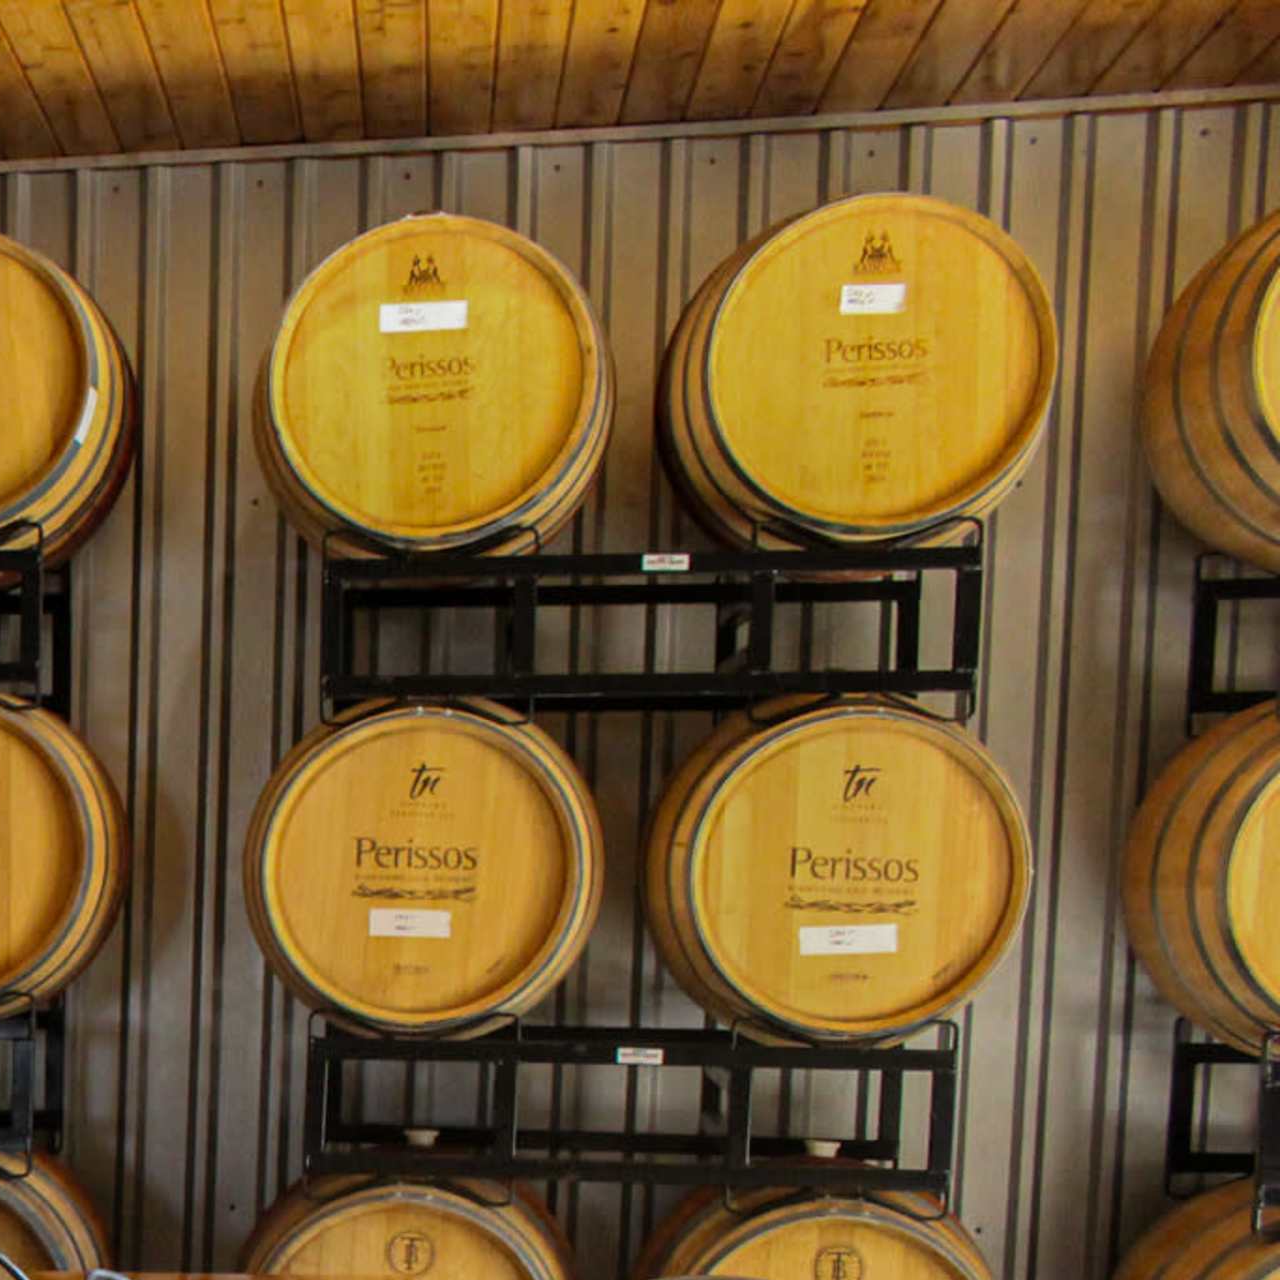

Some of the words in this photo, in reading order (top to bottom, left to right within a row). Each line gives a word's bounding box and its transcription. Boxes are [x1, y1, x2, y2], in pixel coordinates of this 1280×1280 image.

[825, 336, 929, 364] Perissos
[354, 837, 478, 871] Perissos
[789, 846, 919, 882] Perissos
